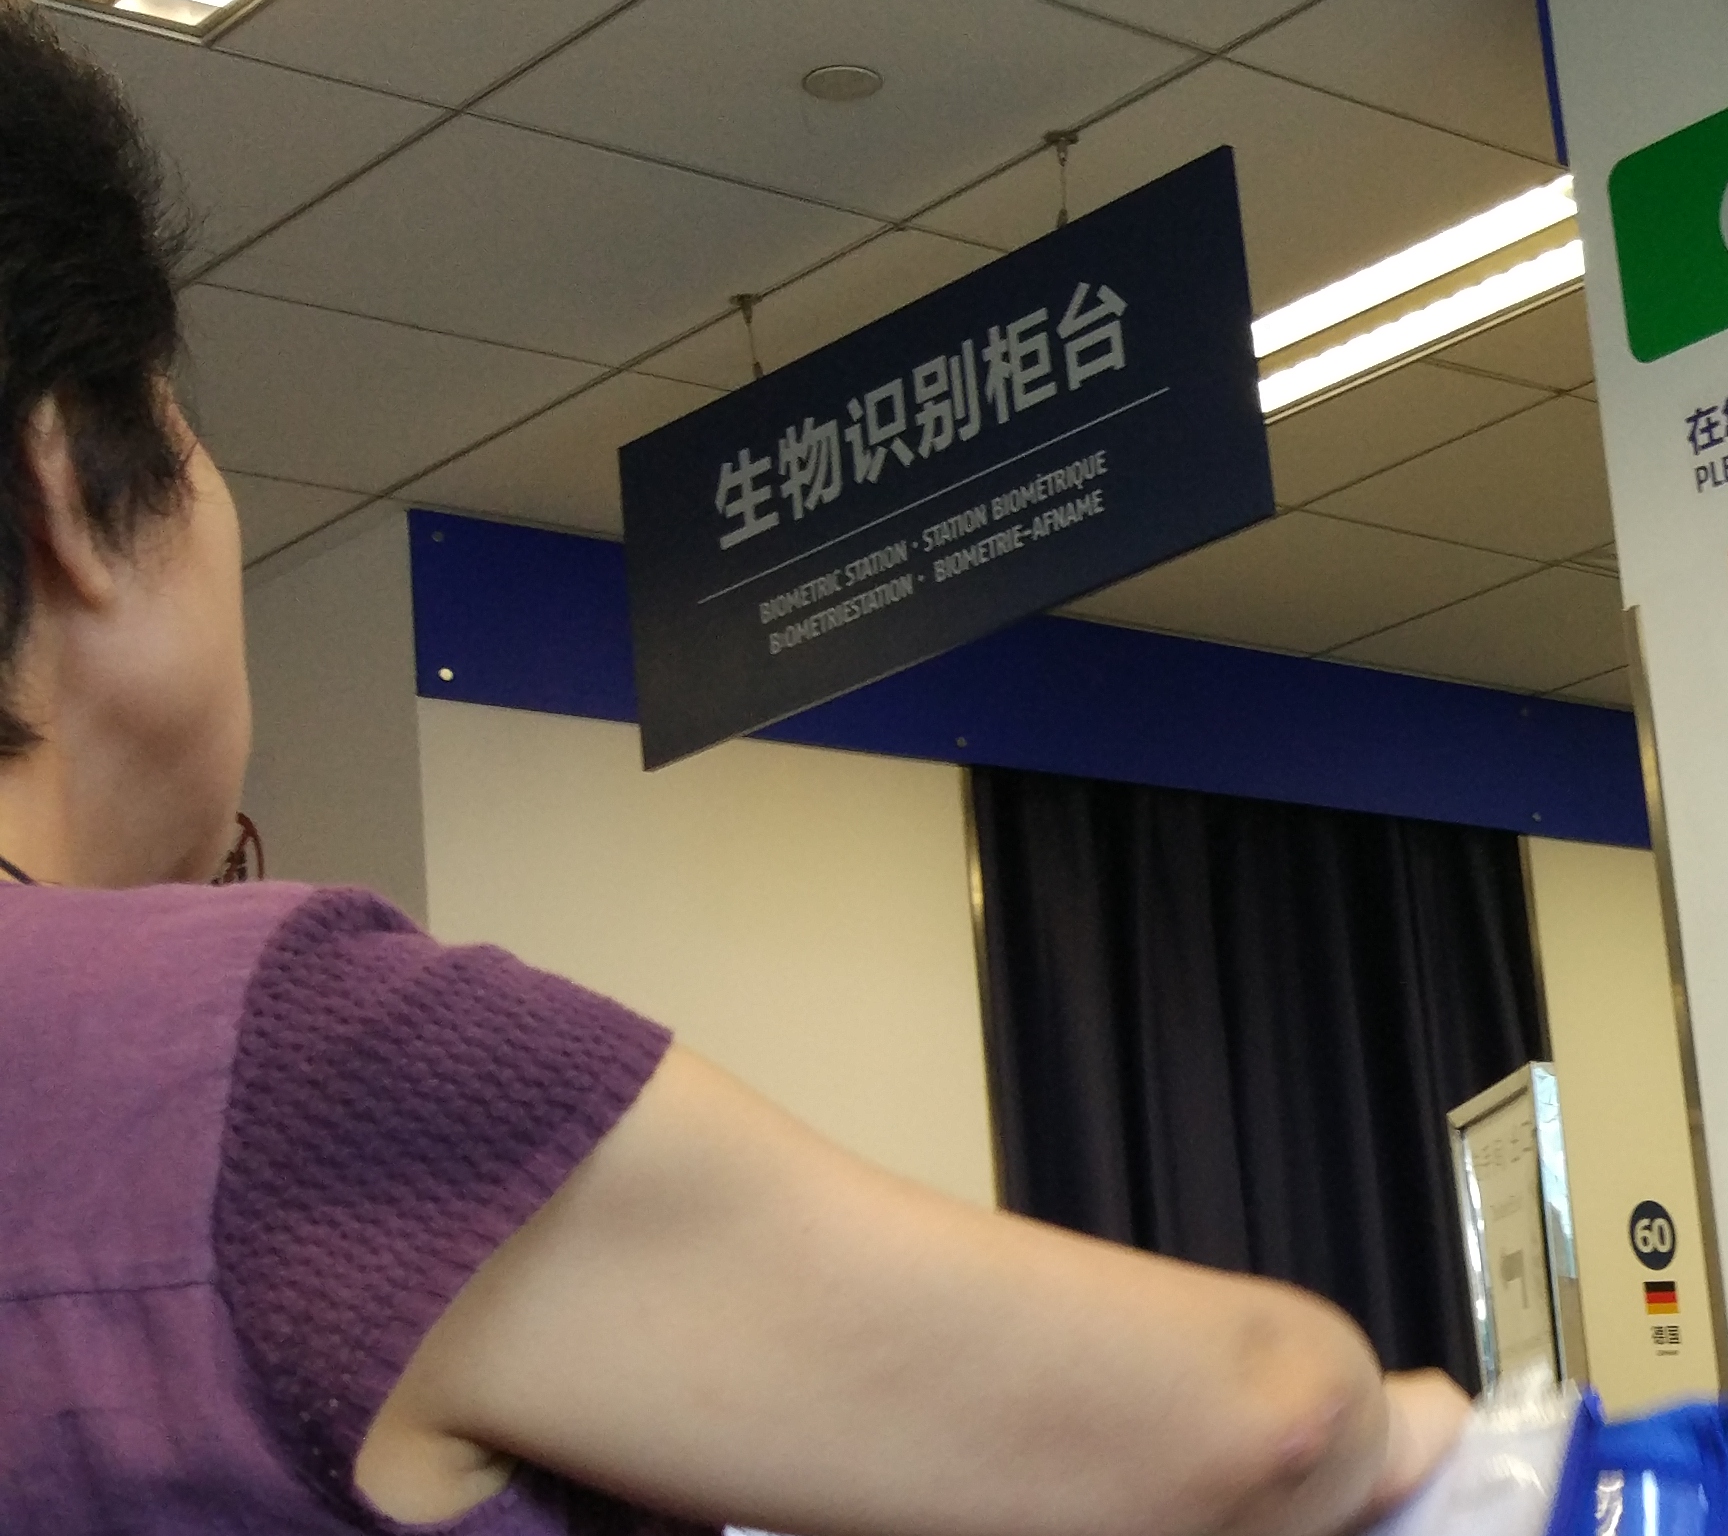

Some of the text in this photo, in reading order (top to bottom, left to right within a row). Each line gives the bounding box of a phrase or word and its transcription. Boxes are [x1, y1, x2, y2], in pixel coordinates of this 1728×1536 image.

[714, 281, 1128, 551] 生物识别柜台
[759, 568, 843, 625] BIOMETRIC
[844, 539, 908, 586] STATION
[922, 503, 989, 552] STATION
[769, 573, 914, 655] BIOMETRIESTATION
[932, 488, 1106, 583] BIOMETRIE-AFNAME
[1634, 1217, 1674, 1254] 60
